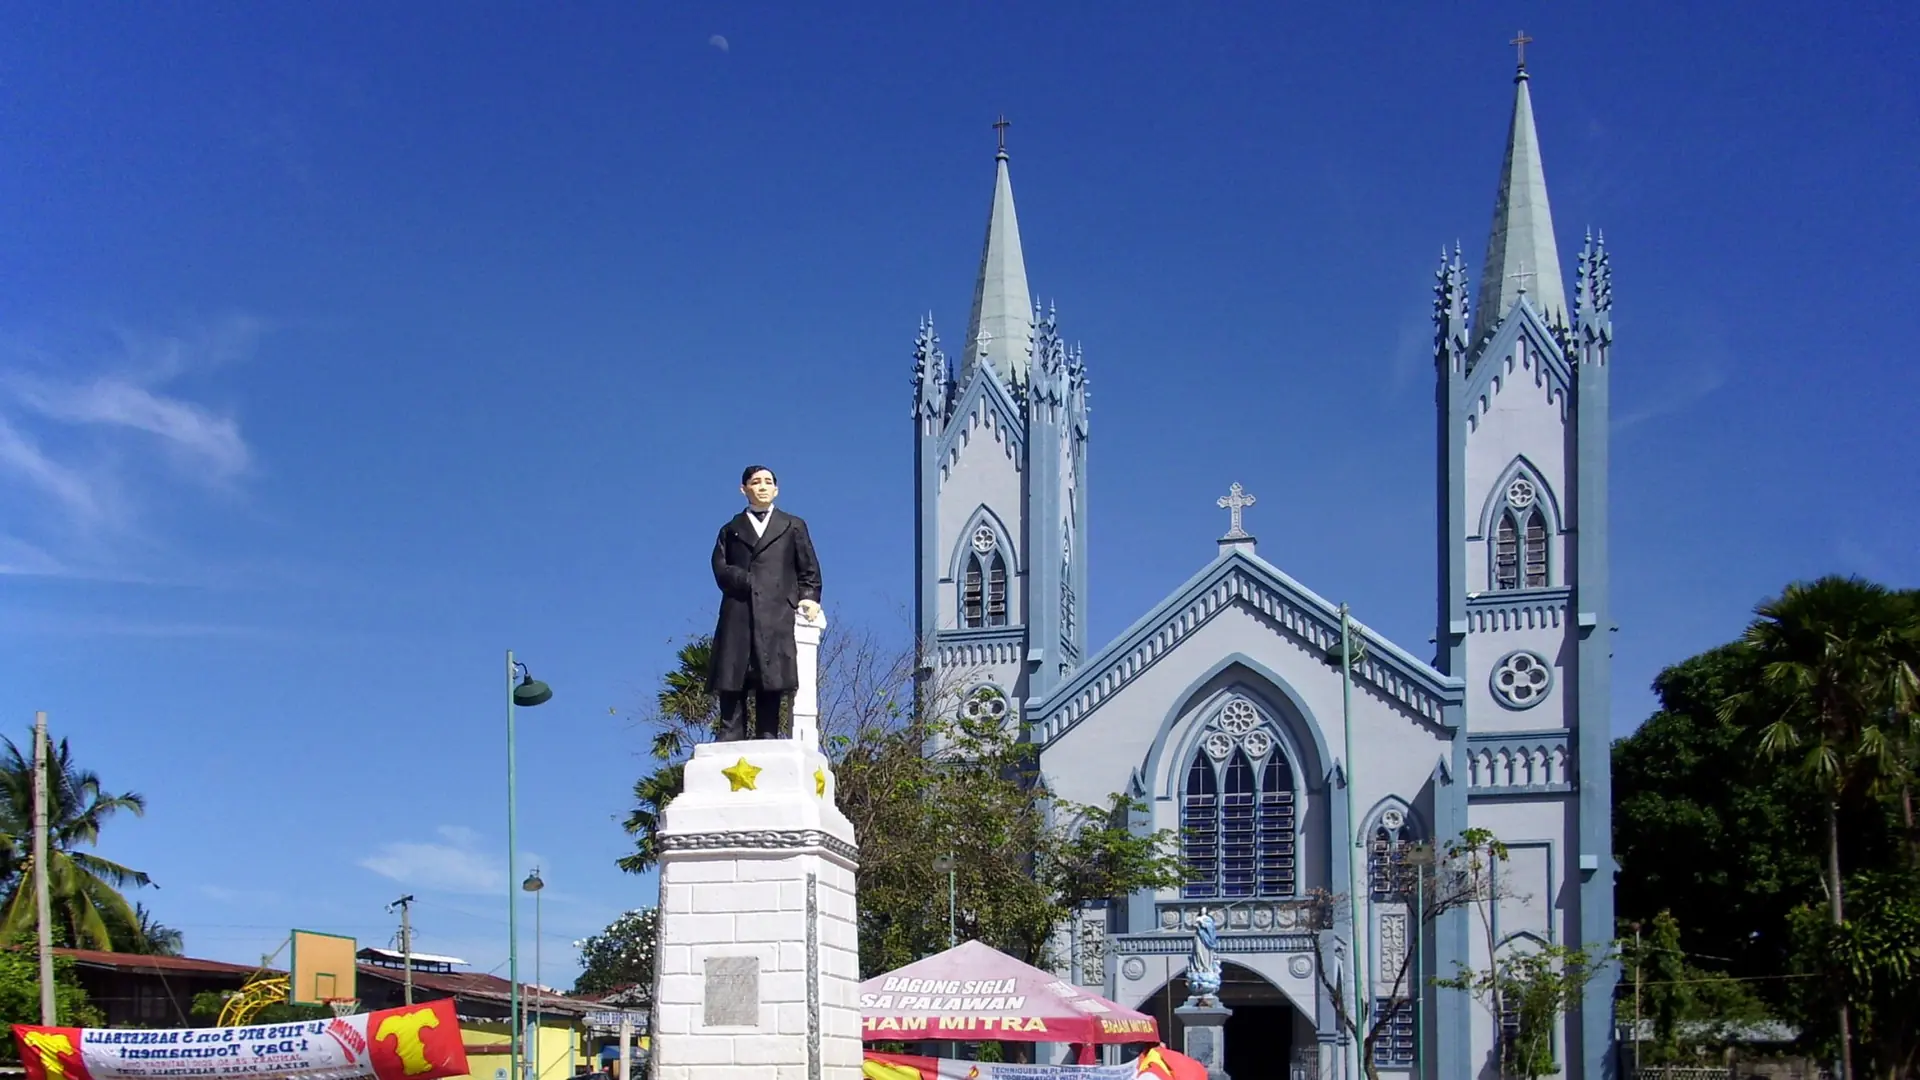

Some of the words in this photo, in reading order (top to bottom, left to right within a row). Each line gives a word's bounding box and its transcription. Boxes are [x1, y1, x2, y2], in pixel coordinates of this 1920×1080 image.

[882, 976, 960, 995] BAGONG
[961, 977, 1017, 995] SIGLA
[860, 993, 893, 1009] SA
[897, 995, 1026, 1011] PALAWAN
[939, 1016, 1048, 1032] MITRA
